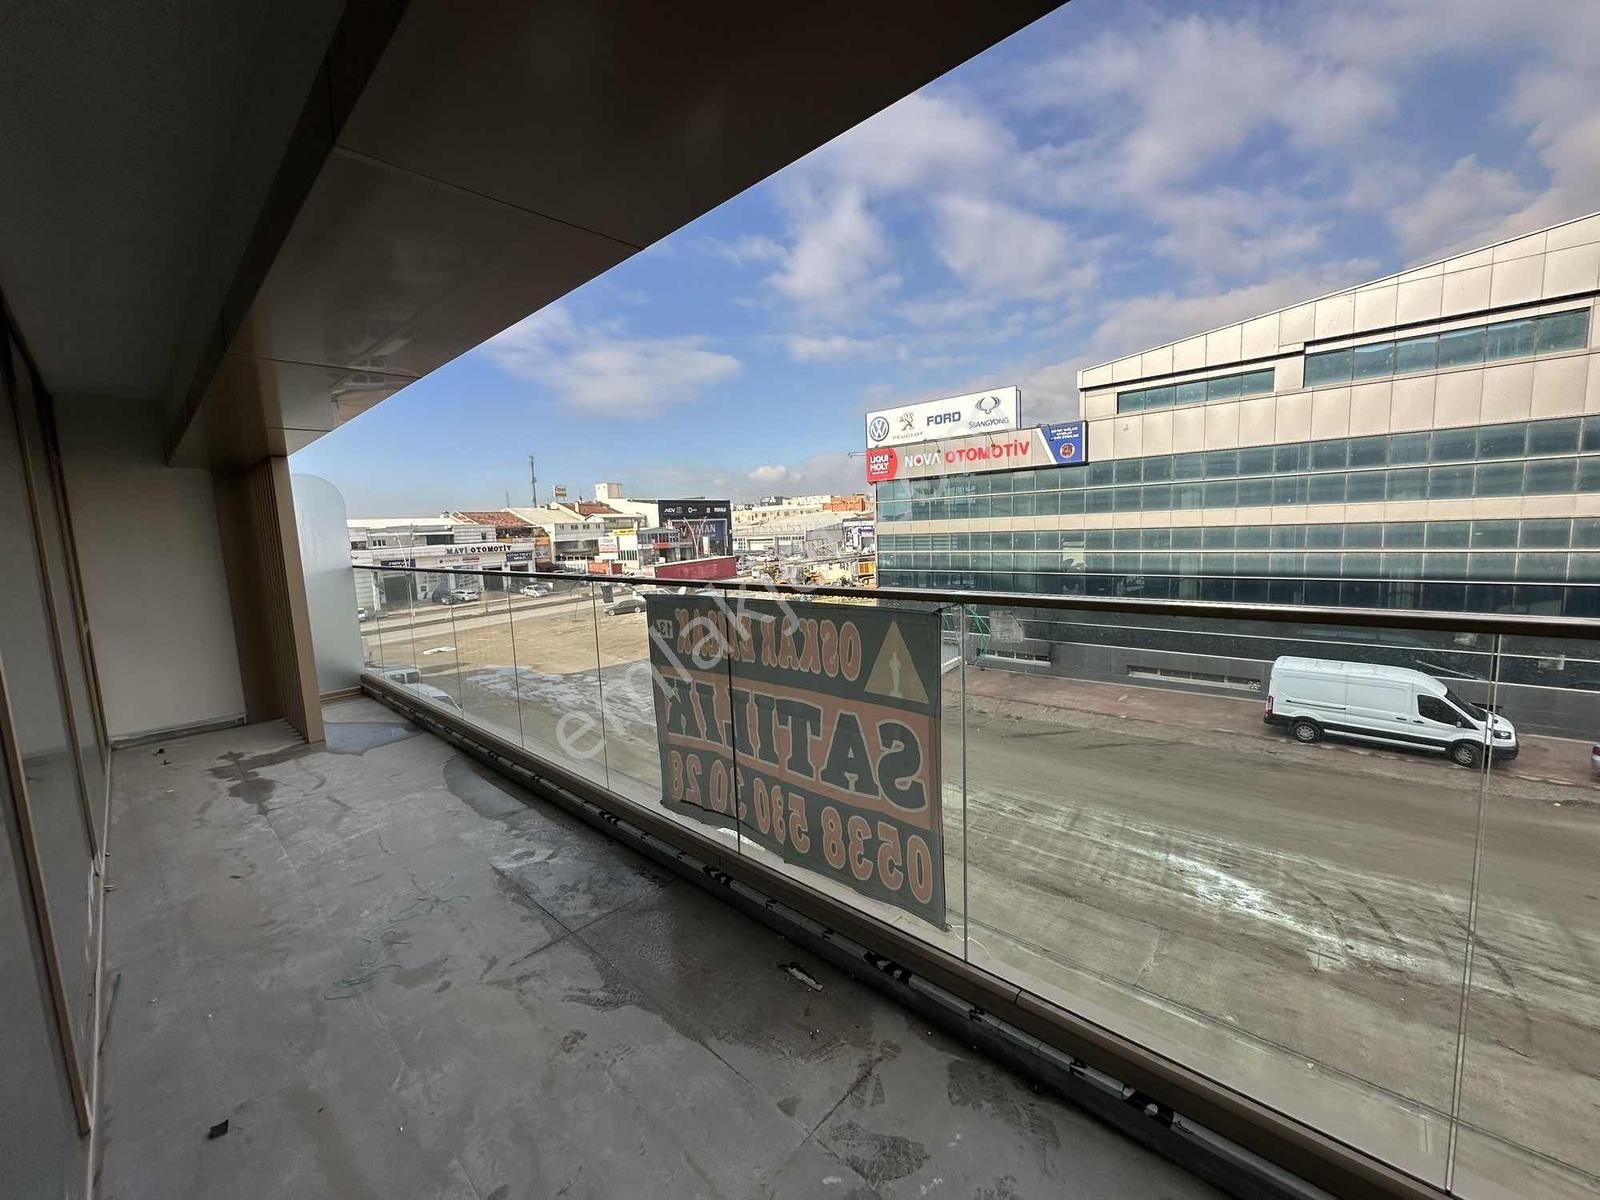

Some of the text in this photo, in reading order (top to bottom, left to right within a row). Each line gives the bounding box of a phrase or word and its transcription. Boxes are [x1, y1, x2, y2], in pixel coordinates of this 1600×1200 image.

[926, 411, 961, 427] FORD
[968, 416, 1010, 430] SSANGYONG
[904, 439, 1030, 468] NOVA OTOMOTİV
[870, 462, 889, 472] MOLY
